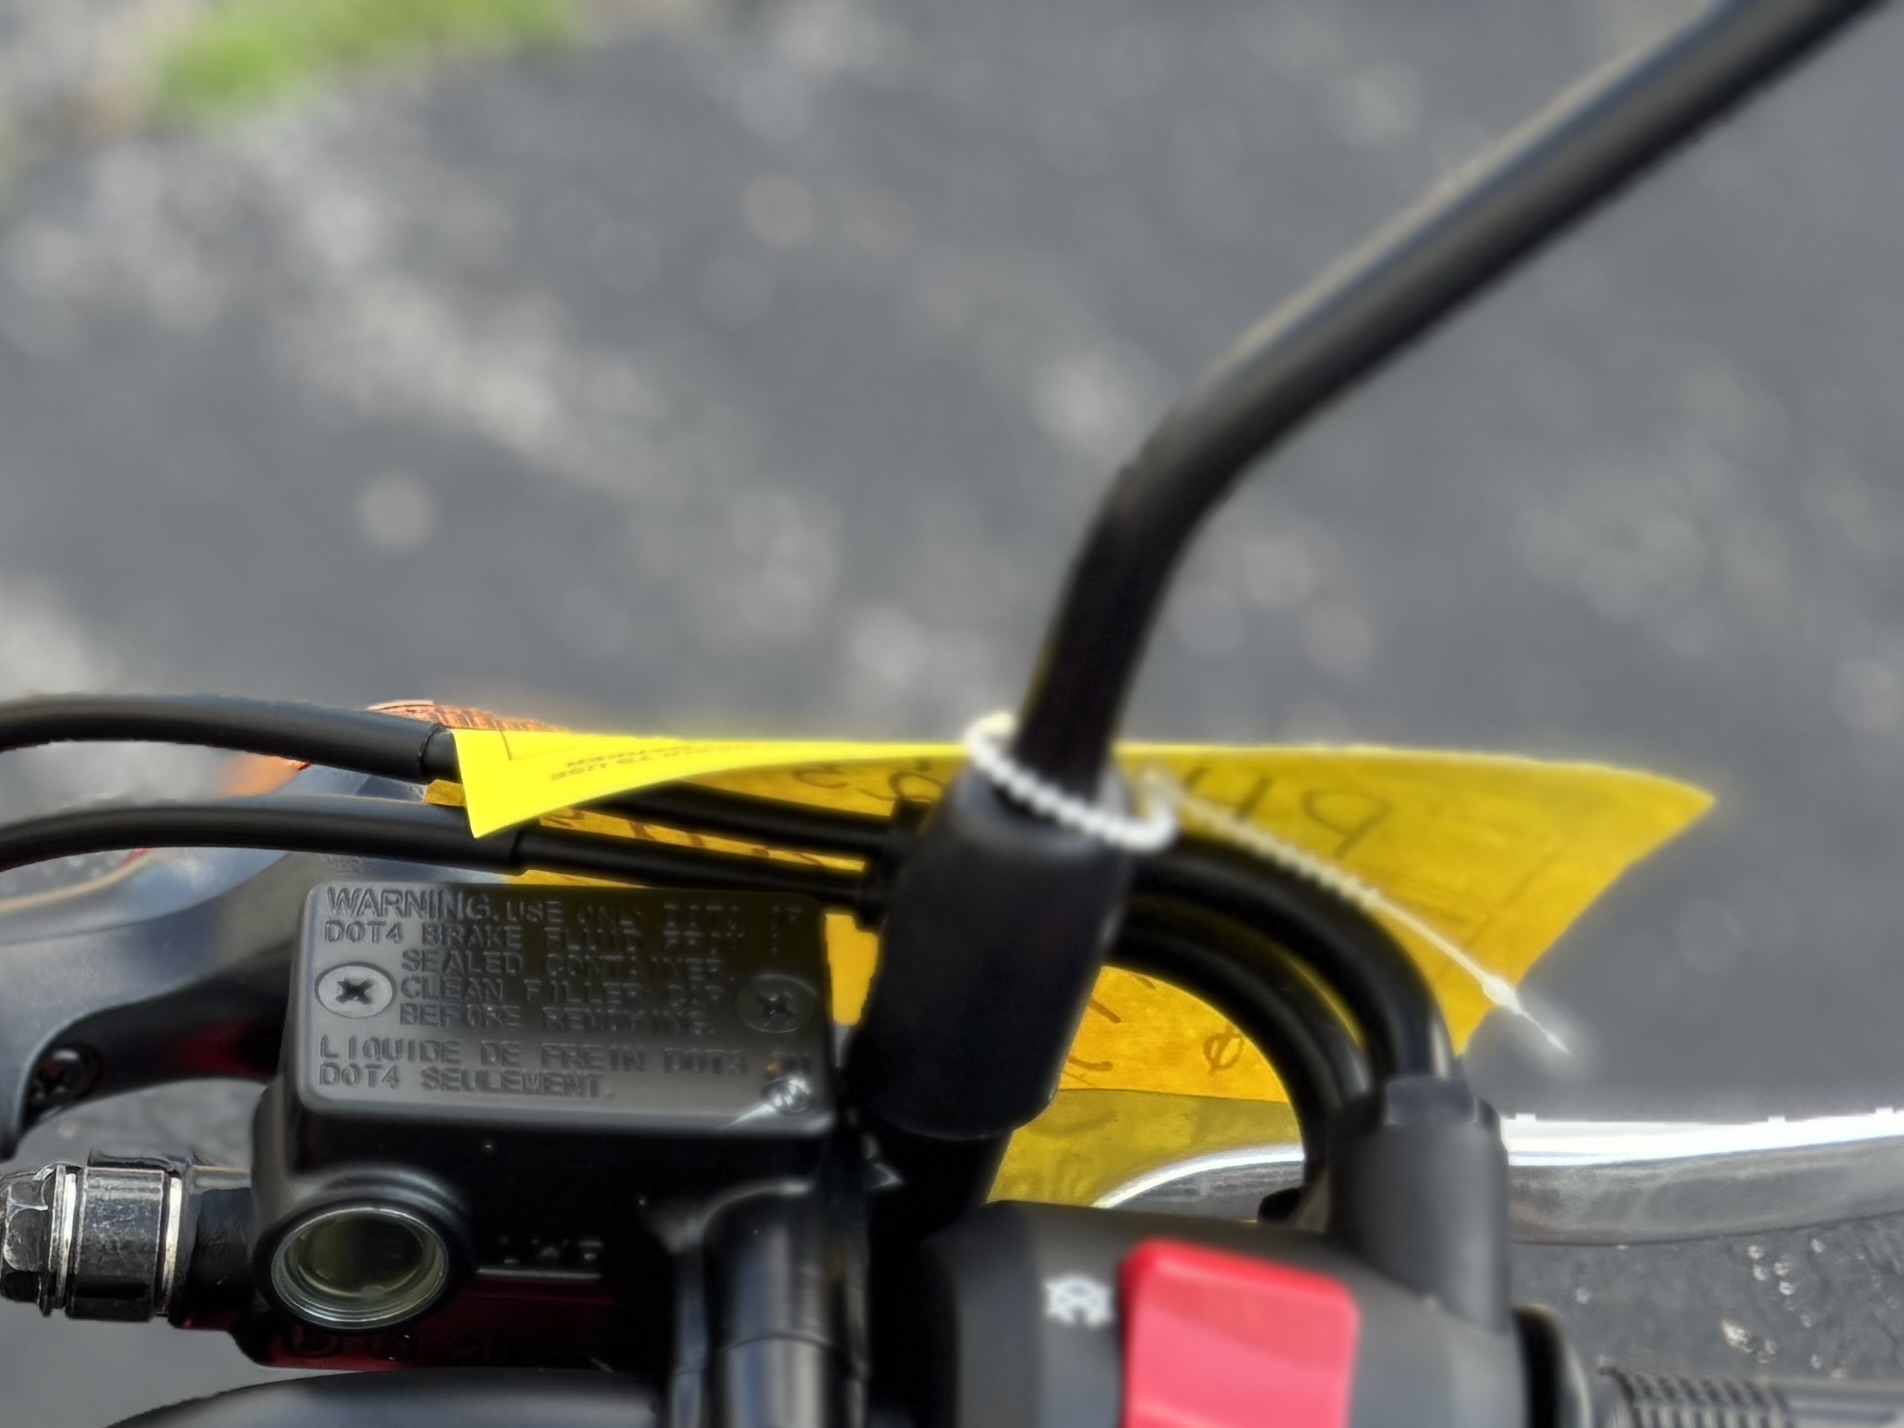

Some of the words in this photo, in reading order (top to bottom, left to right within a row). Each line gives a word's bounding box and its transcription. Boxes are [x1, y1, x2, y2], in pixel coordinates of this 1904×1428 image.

[326, 886, 499, 921] WARNING.
[506, 900, 563, 923] USE
[324, 919, 404, 944] DOT4
[421, 921, 523, 949] BRAKE
[401, 949, 524, 976] SEALED
[400, 975, 504, 1002] CLEAN
[523, 978, 642, 1005] FILLER
[400, 1003, 522, 1029] BEFORE
[320, 1034, 462, 1065] LIQUIDE
[480, 1039, 524, 1068] DE
[541, 1042, 646, 1073] FREIN
[320, 1062, 400, 1089] DOT4
